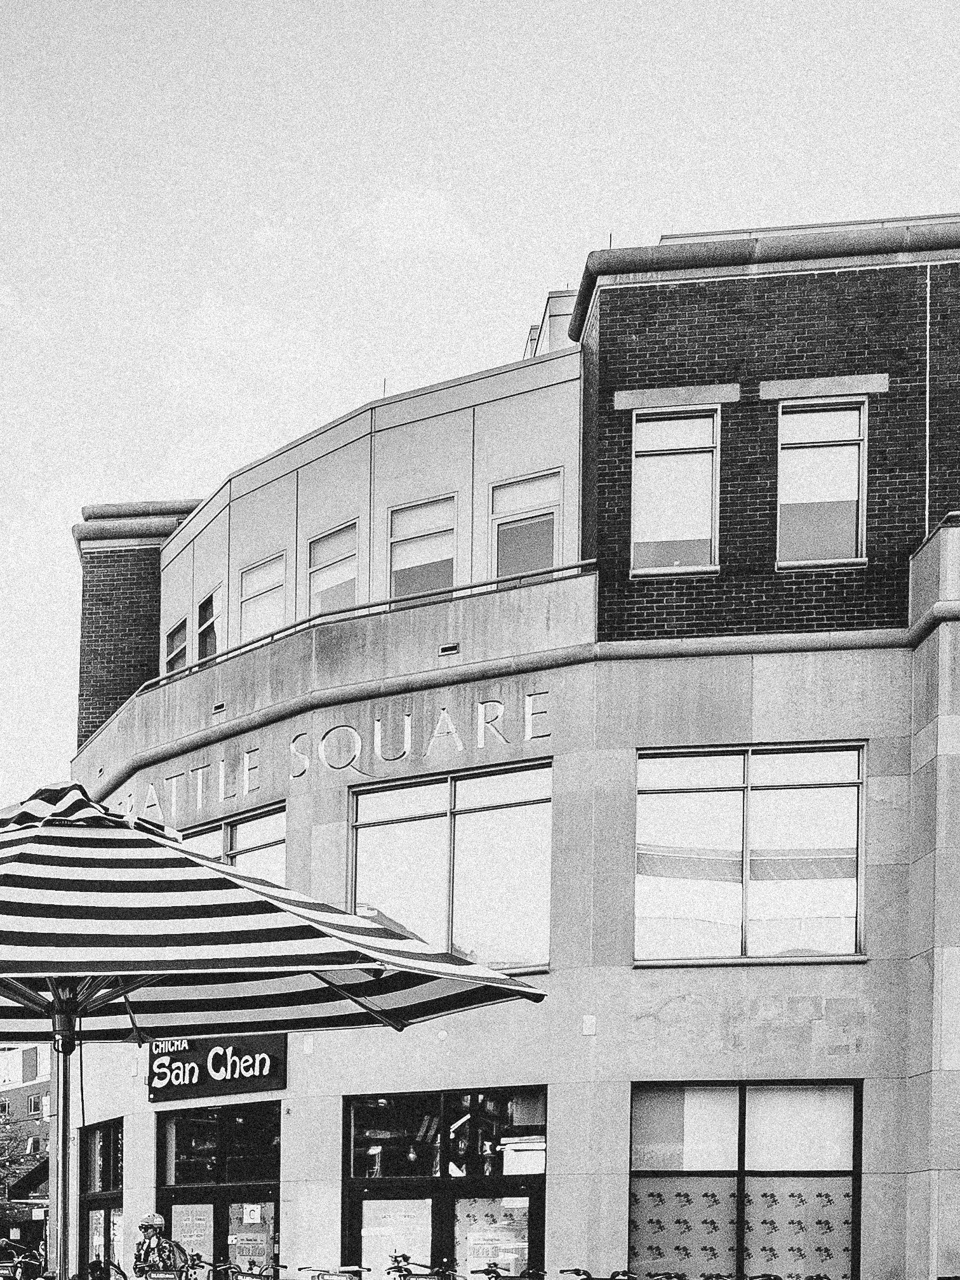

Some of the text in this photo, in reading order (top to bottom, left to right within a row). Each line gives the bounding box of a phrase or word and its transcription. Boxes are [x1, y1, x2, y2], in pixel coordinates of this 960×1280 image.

[289, 690, 552, 779] SQUARE
[151, 1045, 271, 1089] San Chen
